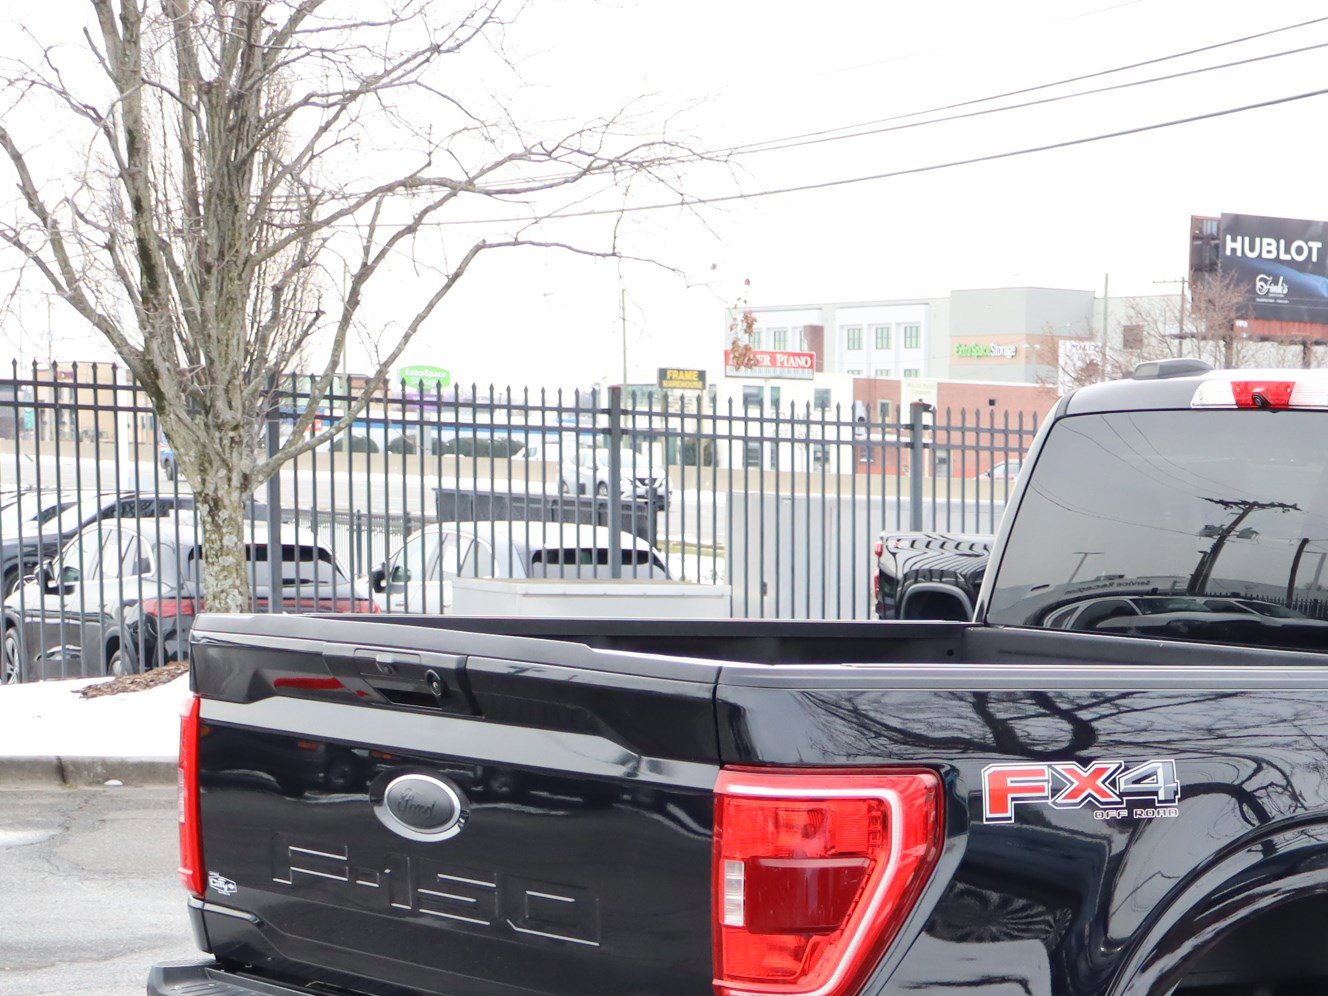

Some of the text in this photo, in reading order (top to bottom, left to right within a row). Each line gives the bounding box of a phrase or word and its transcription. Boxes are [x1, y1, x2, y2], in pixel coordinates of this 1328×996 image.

[1225, 234, 1322, 262] HUBLOT
[776, 354, 812, 368] PIANO
[666, 369, 699, 381] FRAME
[981, 759, 1180, 824] FX4
[1094, 807, 1179, 820] OFF ROAD
[270, 830, 601, 948] F-150
